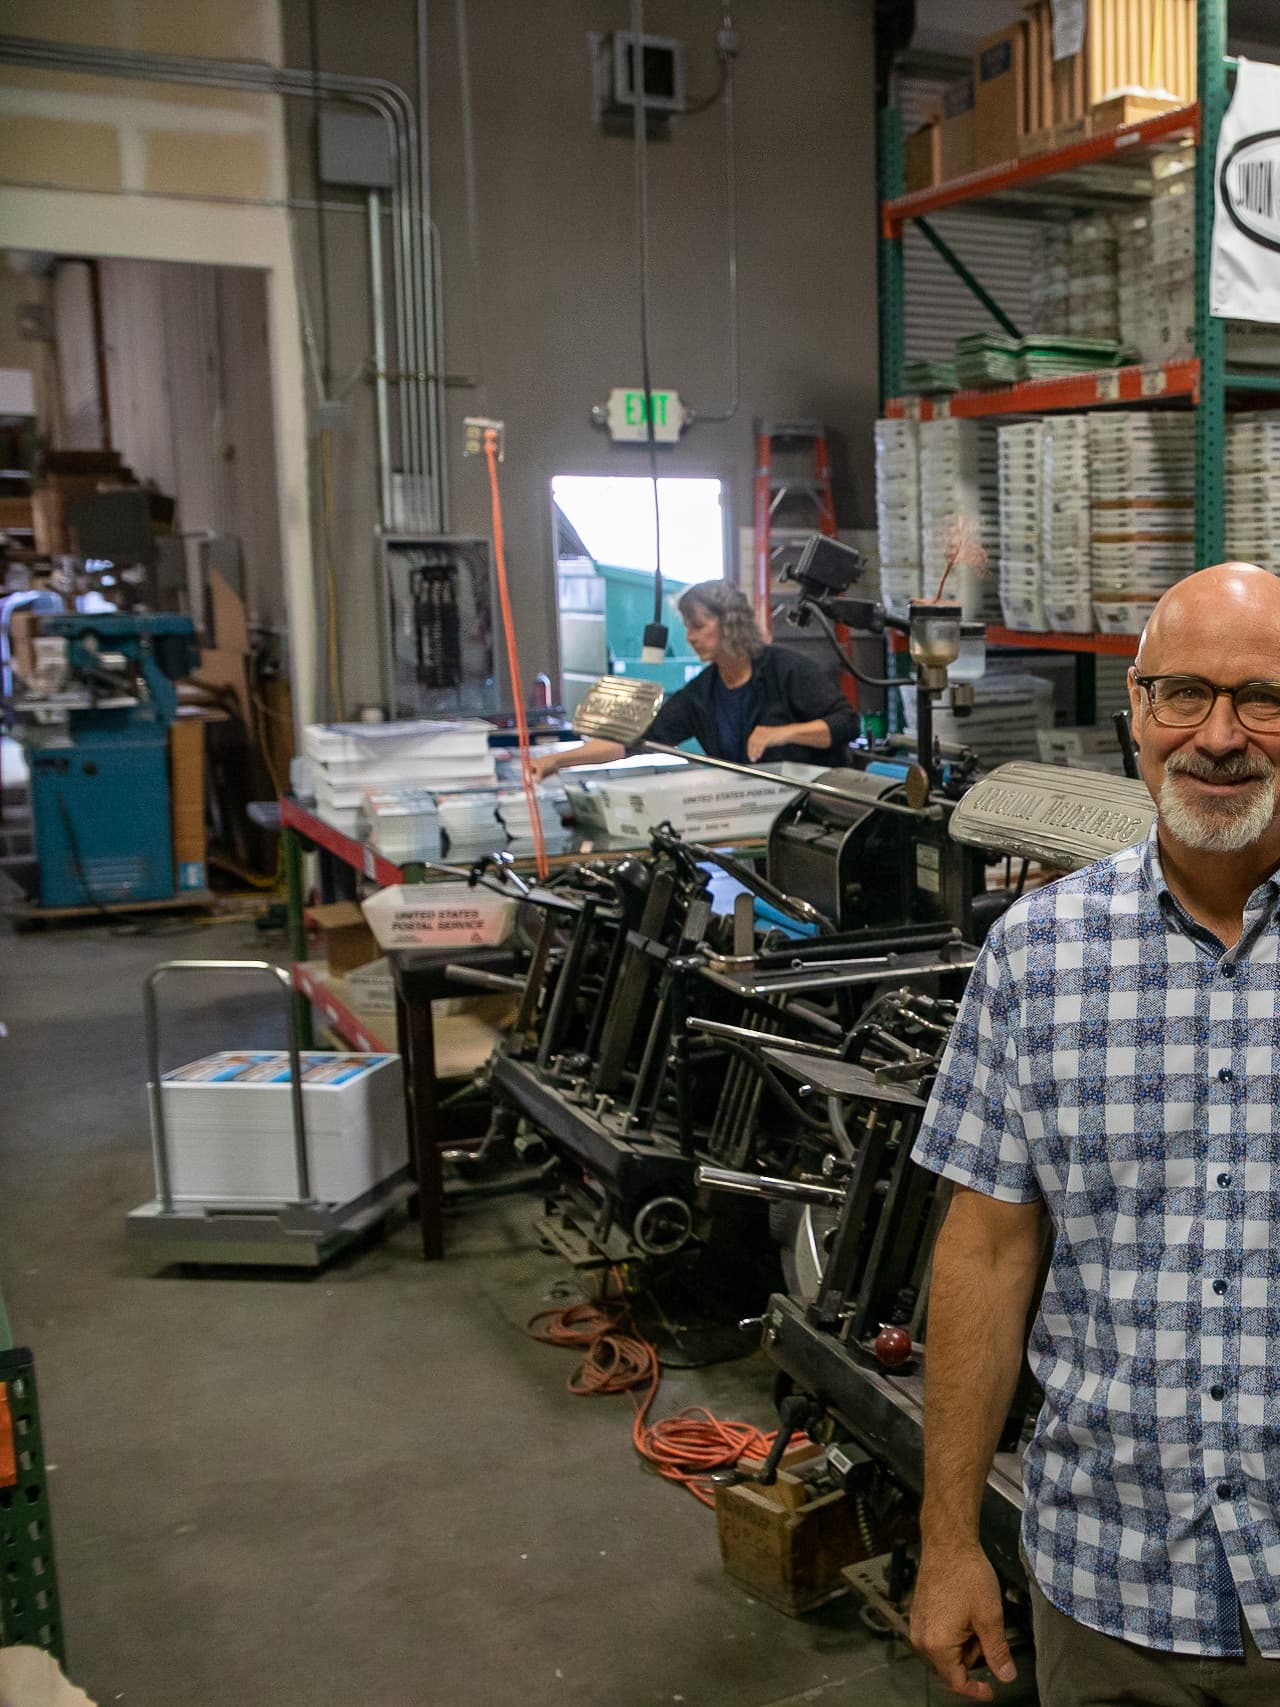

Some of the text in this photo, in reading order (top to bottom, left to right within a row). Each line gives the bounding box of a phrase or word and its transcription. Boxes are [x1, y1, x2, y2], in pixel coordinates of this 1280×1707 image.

[973, 787, 1144, 843] ORIGINAL HEIDELBERG
[395, 909, 479, 919] UNITED STATES
[392, 919, 485, 930] POSTAL SERVICE
